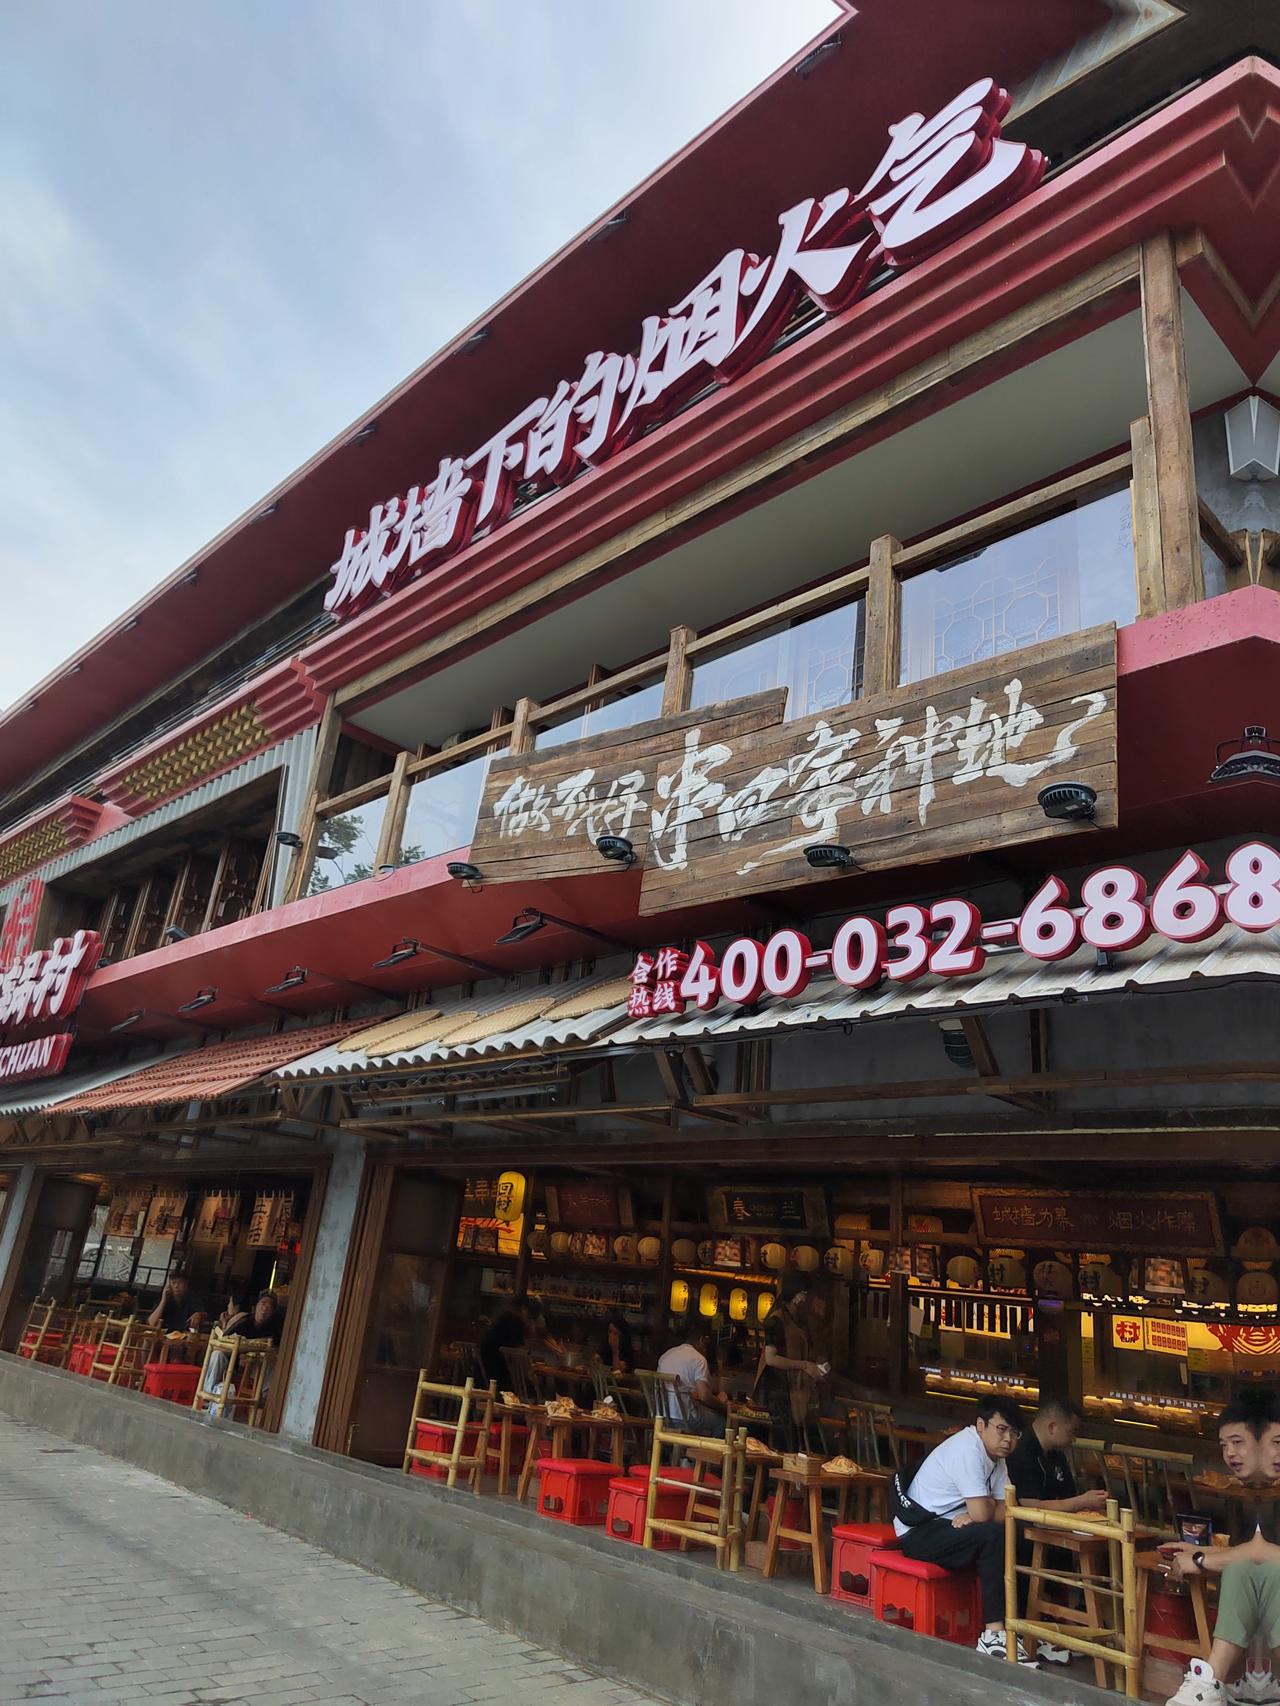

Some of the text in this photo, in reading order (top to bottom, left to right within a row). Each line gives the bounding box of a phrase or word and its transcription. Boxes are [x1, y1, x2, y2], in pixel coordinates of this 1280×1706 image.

[323, 77, 1027, 612] 城墙下的烟火气
[680, 840, 1280, 1008] 400-032-6868
[627, 949, 679, 985] 合作
[627, 981, 677, 1017] 热线
[0, 1035, 56, 1078] CHUAN
